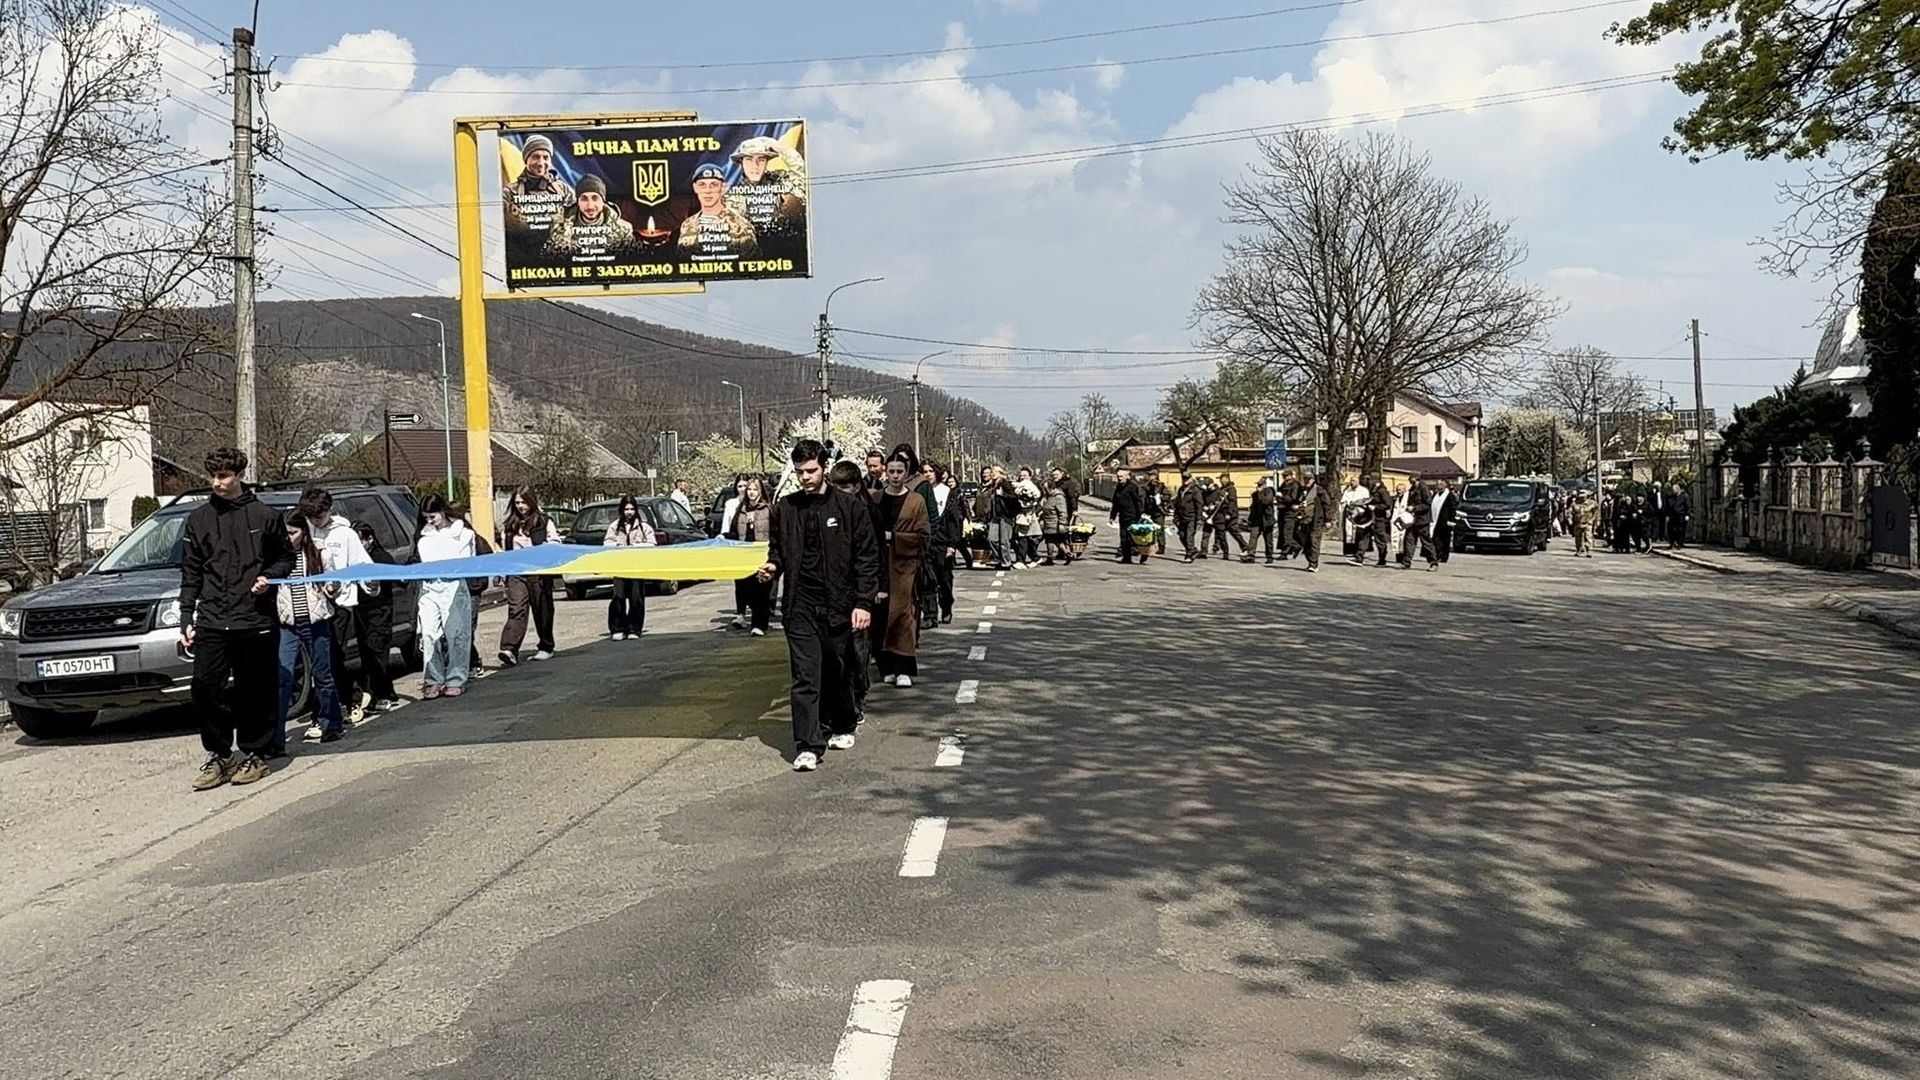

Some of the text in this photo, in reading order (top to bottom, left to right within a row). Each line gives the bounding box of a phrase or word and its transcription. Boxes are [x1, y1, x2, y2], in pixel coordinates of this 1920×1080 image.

[572, 136, 721, 155] ВІЧНА ПАМ'ЯТЬ
[746, 195, 777, 205] РОМАН
[578, 235, 607, 245] СЕРГІЙ
[698, 232, 732, 242] ВАСИЛЬ
[511, 267, 566, 279] НІКОЛИ
[571, 266, 592, 277] НЕ
[597, 263, 673, 277] ЗАБУДЕМО
[679, 262, 734, 274] НАШИХ
[45, 657, 110, 674] AT 0570 HT
